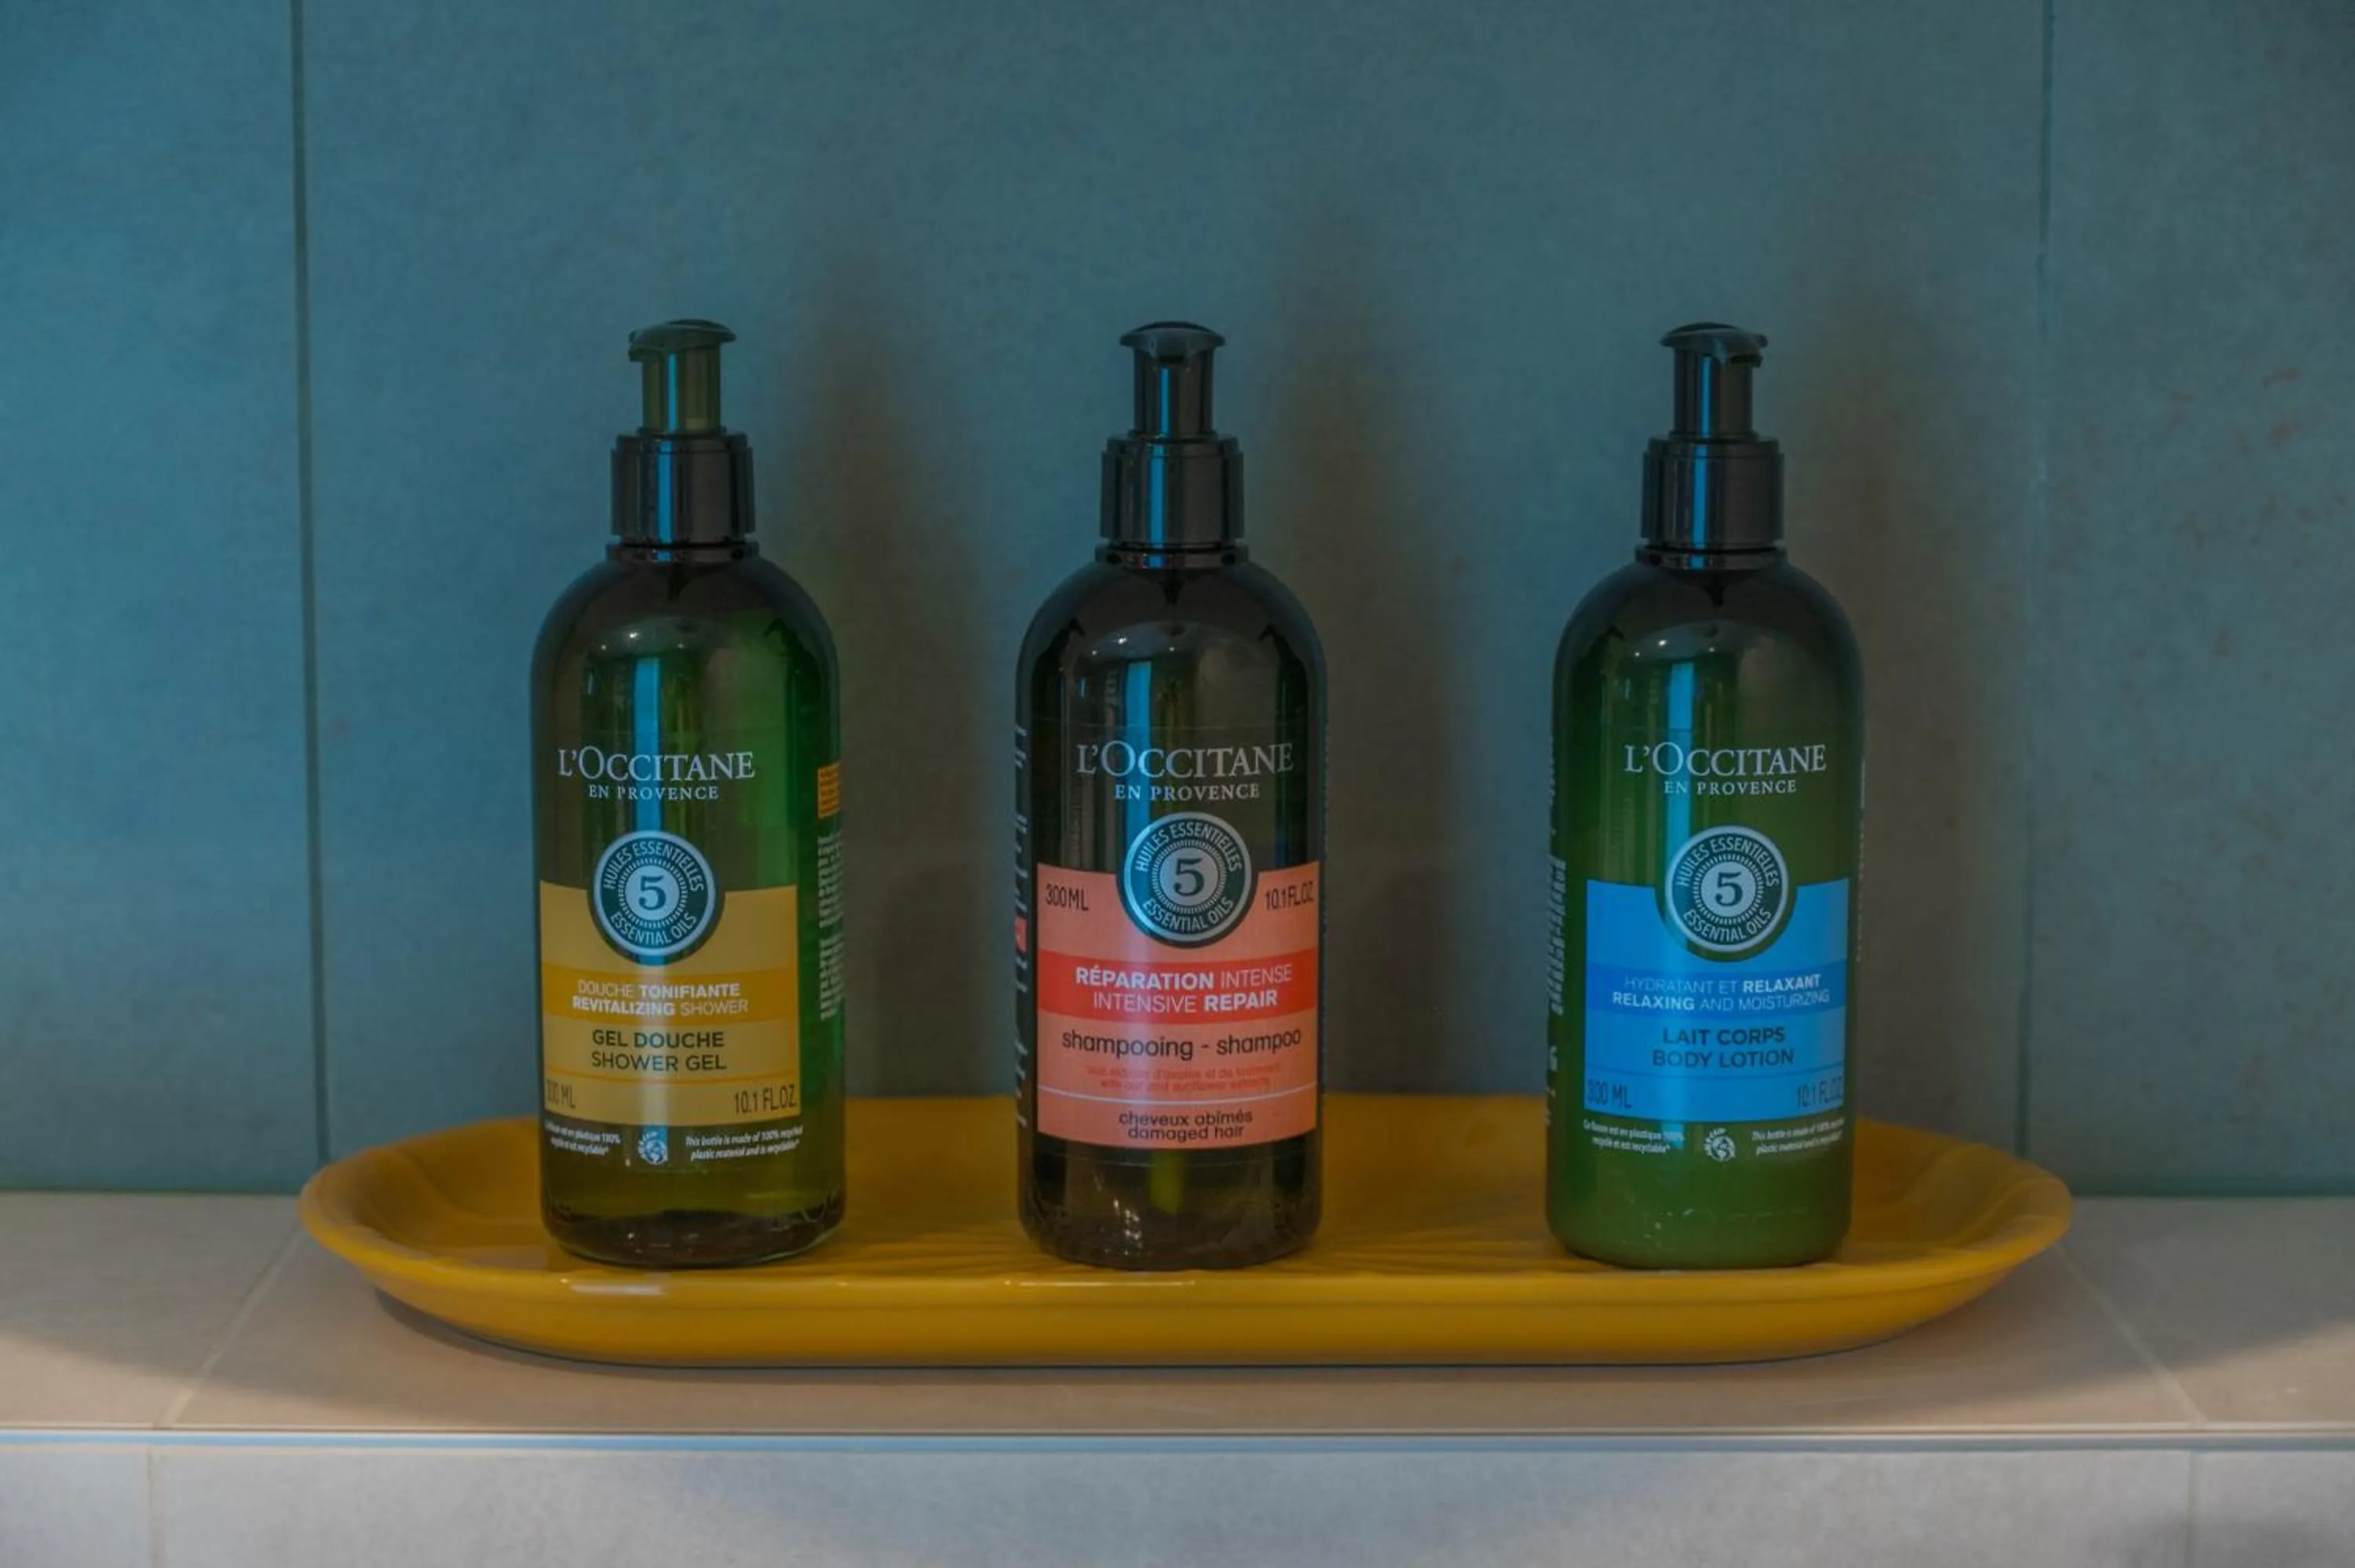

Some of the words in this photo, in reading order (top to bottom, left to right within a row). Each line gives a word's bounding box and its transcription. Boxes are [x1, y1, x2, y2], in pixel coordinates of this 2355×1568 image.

[558, 746, 755, 782] L'OCCITANE
[1077, 740, 1294, 779] L'OCCITANE
[1623, 742, 1827, 777] L'OCCITANE
[589, 784, 609, 799] EN
[617, 785, 719, 800] PROVENCE
[1115, 784, 1141, 800] EN
[1151, 783, 1260, 801] PROVENCE
[1663, 781, 1689, 794] EN
[1697, 779, 1797, 796] PROVENCE
[1135, 829, 1169, 872] HUILES
[1170, 822, 1243, 873] ESSENTIELLES
[603, 848, 632, 889] HUILES
[633, 841, 703, 892] ESSENTIELLES
[1675, 844, 1709, 887] HUILES
[1711, 837, 1780, 888] ESSENTIELLES
[1173, 858, 1205, 896] 5
[1714, 870, 1743, 906] 5
[638, 875, 666, 910] 5
[1142, 898, 1207, 932] ESSENTIAL
[1209, 898, 1234, 925] OILS
[1682, 909, 1746, 942] ESSENTIAL
[1747, 908, 1772, 936] OILS
[610, 911, 671, 946] ESSENTIAL
[673, 912, 697, 941] OILS
[577, 979, 635, 997] DOUCHE
[639, 983, 740, 999] TONIFIANTE
[1075, 965, 1214, 990] RÉPARATION
[1221, 964, 1294, 987] INTENSE
[1624, 975, 1712, 994] HYDRATANT
[1718, 980, 1737, 994] ET
[1743, 973, 1820, 994] RELAXANT
[572, 994, 675, 1016] REVITALIZING
[680, 1001, 749, 1017] SHOWER
[1094, 993, 1196, 1014] INTENSIVE
[1204, 990, 1279, 1012] REPAIR
[1612, 990, 1695, 1011] RELAXING
[1700, 997, 1734, 1012] AND
[1738, 988, 1830, 1012] MOISTURIZING
[592, 1029, 628, 1048] GEL
[634, 1031, 725, 1049] DOUCHE
[1062, 1030, 1193, 1061] shampooing
[1216, 1027, 1302, 1059] shampoo
[1663, 1027, 1711, 1045] LAIT
[1716, 1026, 1785, 1045] CORPS
[591, 1053, 678, 1071] SHOWER
[685, 1053, 727, 1071] GEL
[1652, 1049, 1712, 1069] BODY
[1719, 1048, 1795, 1068] LOTION
[1612, 1082, 1633, 1109] ML
[1119, 1110, 1189, 1126] cheveux
[1128, 1124, 1208, 1143] damaged
[1214, 1125, 1244, 1139] hair
